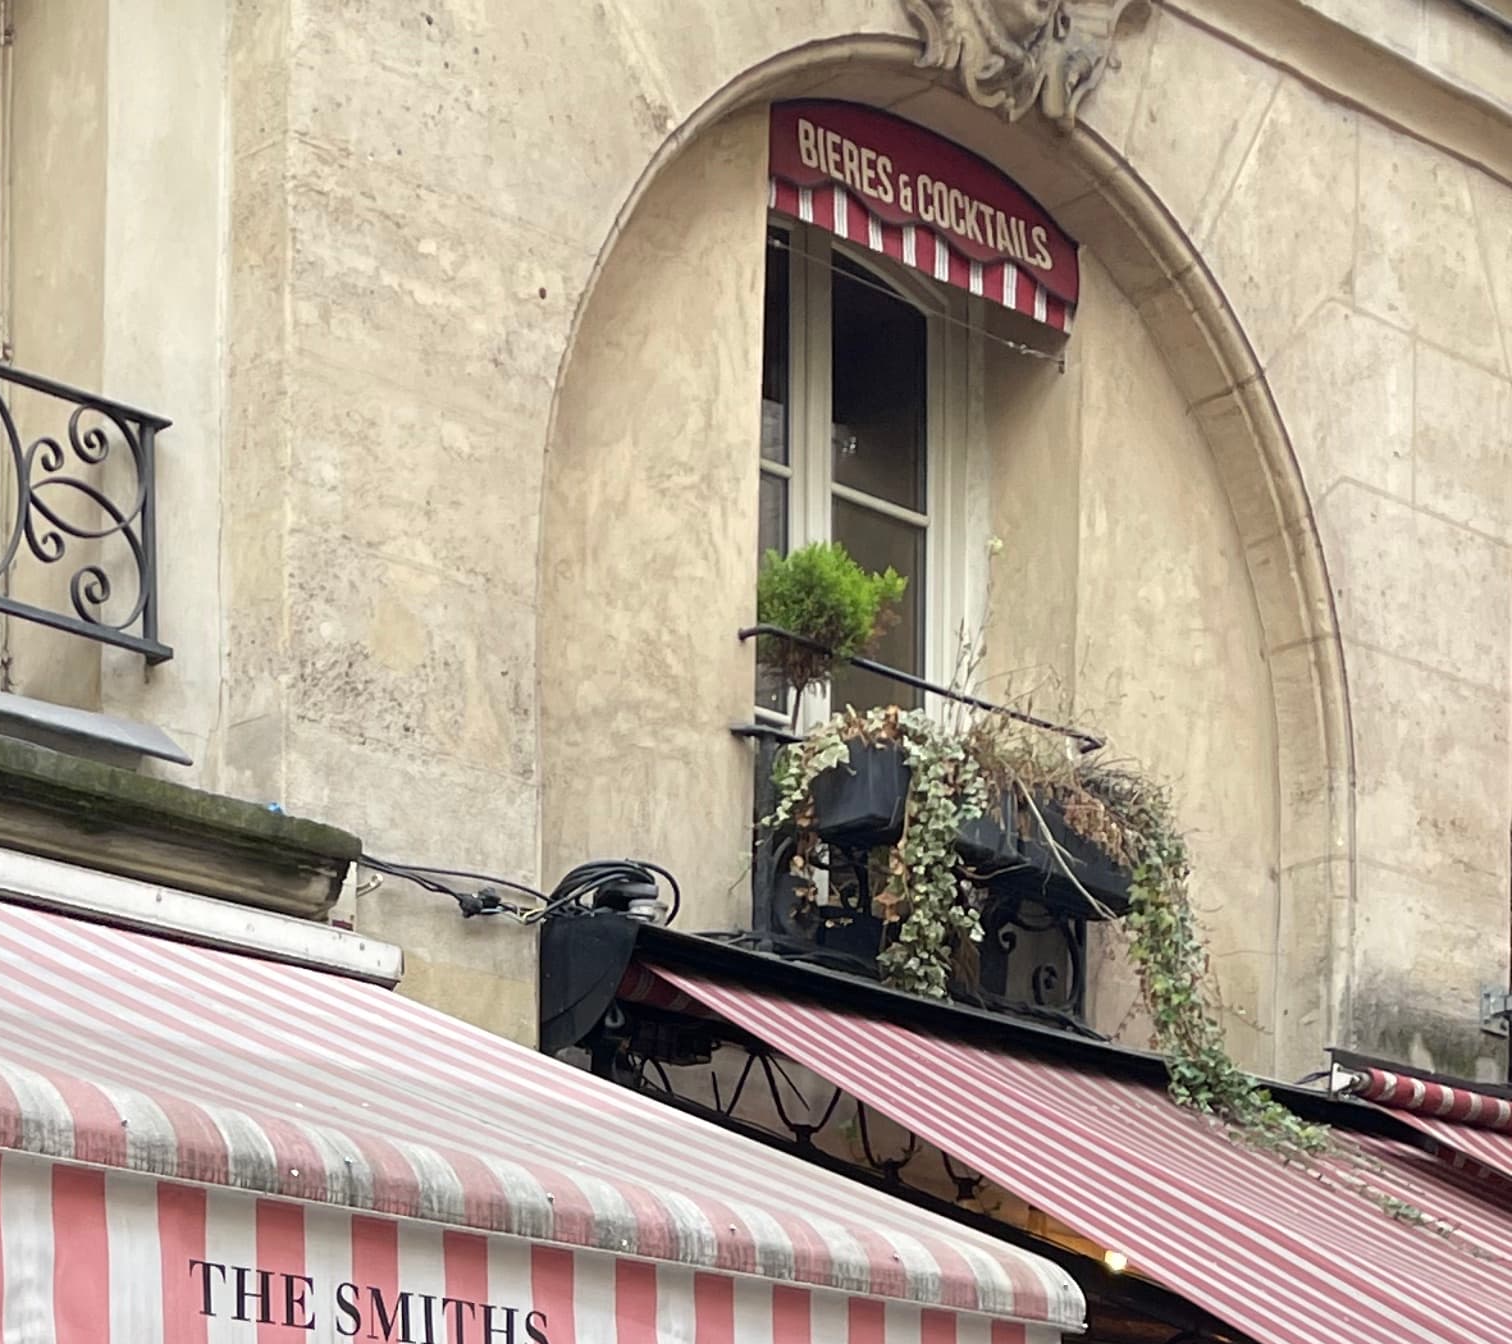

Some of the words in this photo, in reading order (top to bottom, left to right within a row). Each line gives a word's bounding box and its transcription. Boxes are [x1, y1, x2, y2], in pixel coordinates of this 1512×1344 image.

[798, 118, 894, 205] BIERES
[899, 174, 913, 215] &
[916, 175, 1054, 271] COCKTAILS
[189, 1259, 316, 1330] THE
